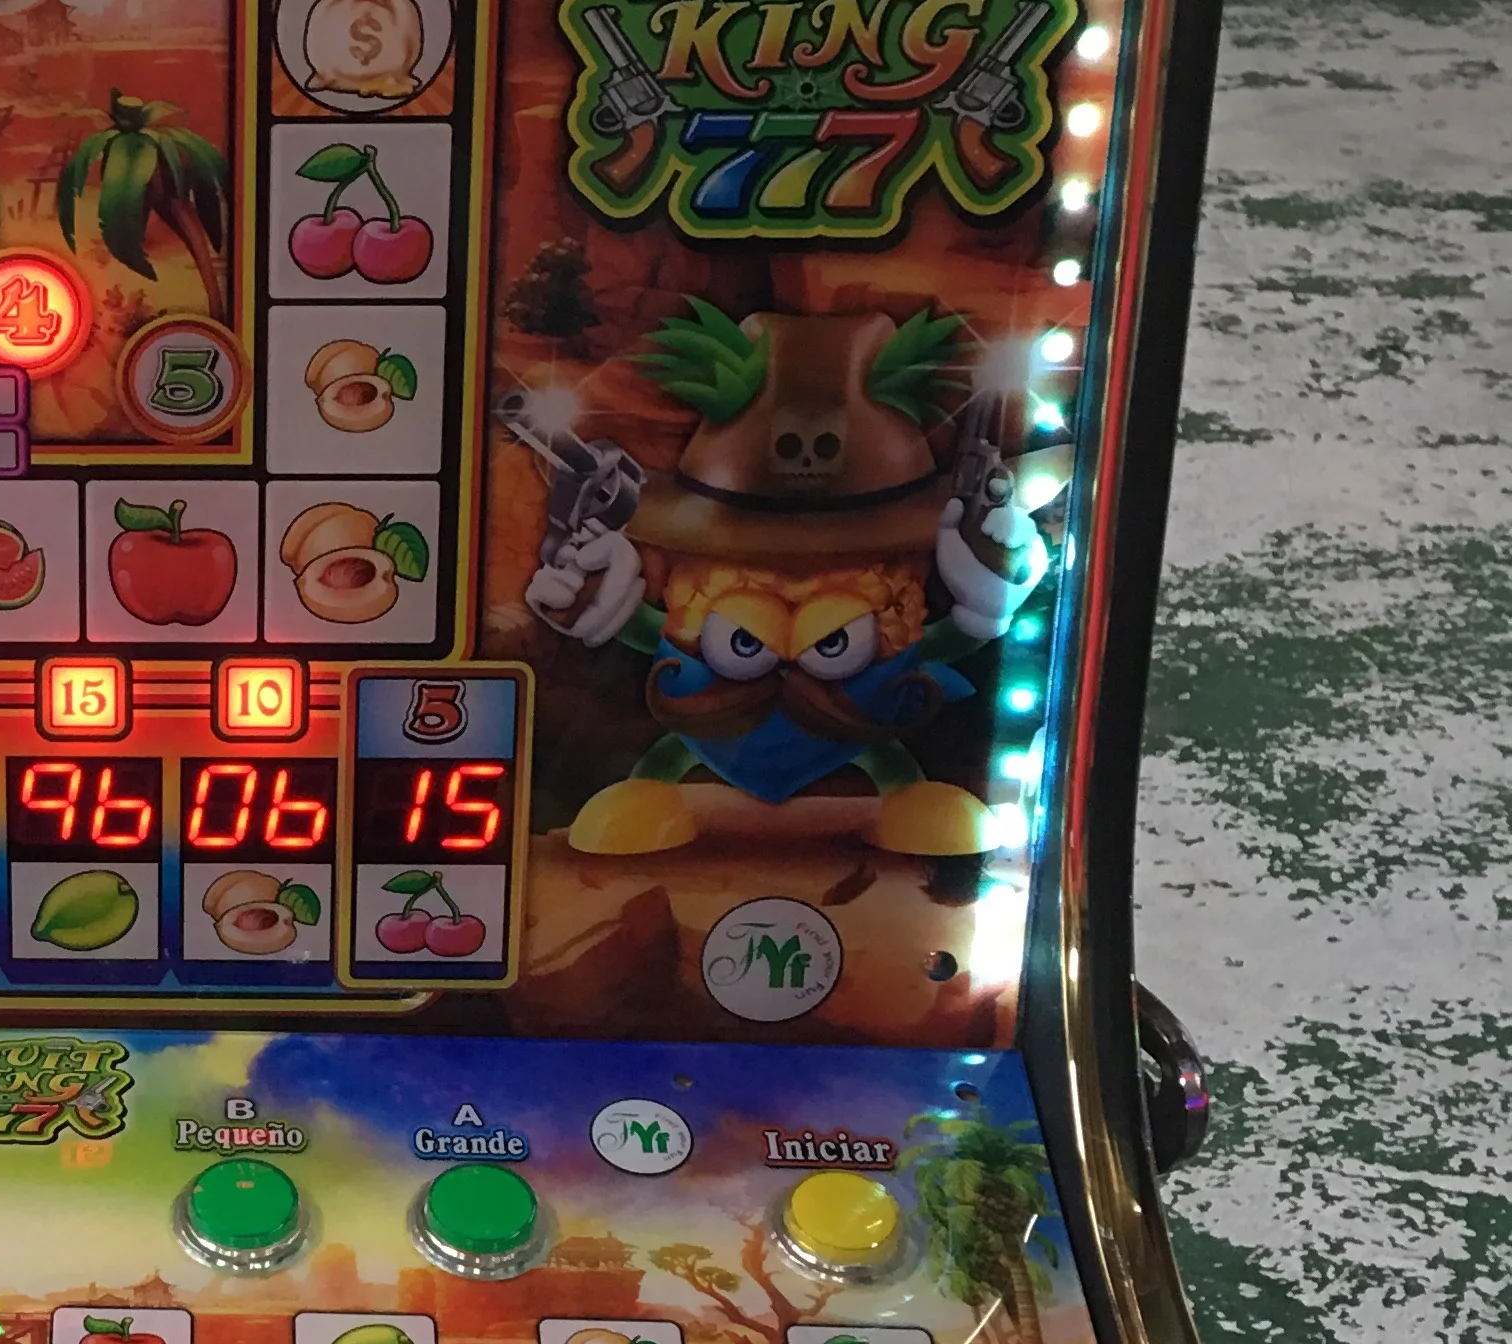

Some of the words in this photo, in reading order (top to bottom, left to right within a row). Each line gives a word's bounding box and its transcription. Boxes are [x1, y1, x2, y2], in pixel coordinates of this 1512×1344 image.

[682, 110, 928, 214] 777
[151, 349, 220, 414] 5
[61, 677, 108, 717] 15
[236, 677, 284, 717] 10
[406, 682, 465, 738] 5
[404, 765, 506, 849] 15
[226, 1099, 257, 1121] B
[453, 1104, 483, 1127] A
[177, 1120, 305, 1151] Pequeño
[414, 1129, 525, 1158] Grande
[766, 1131, 892, 1165] Iniciar
